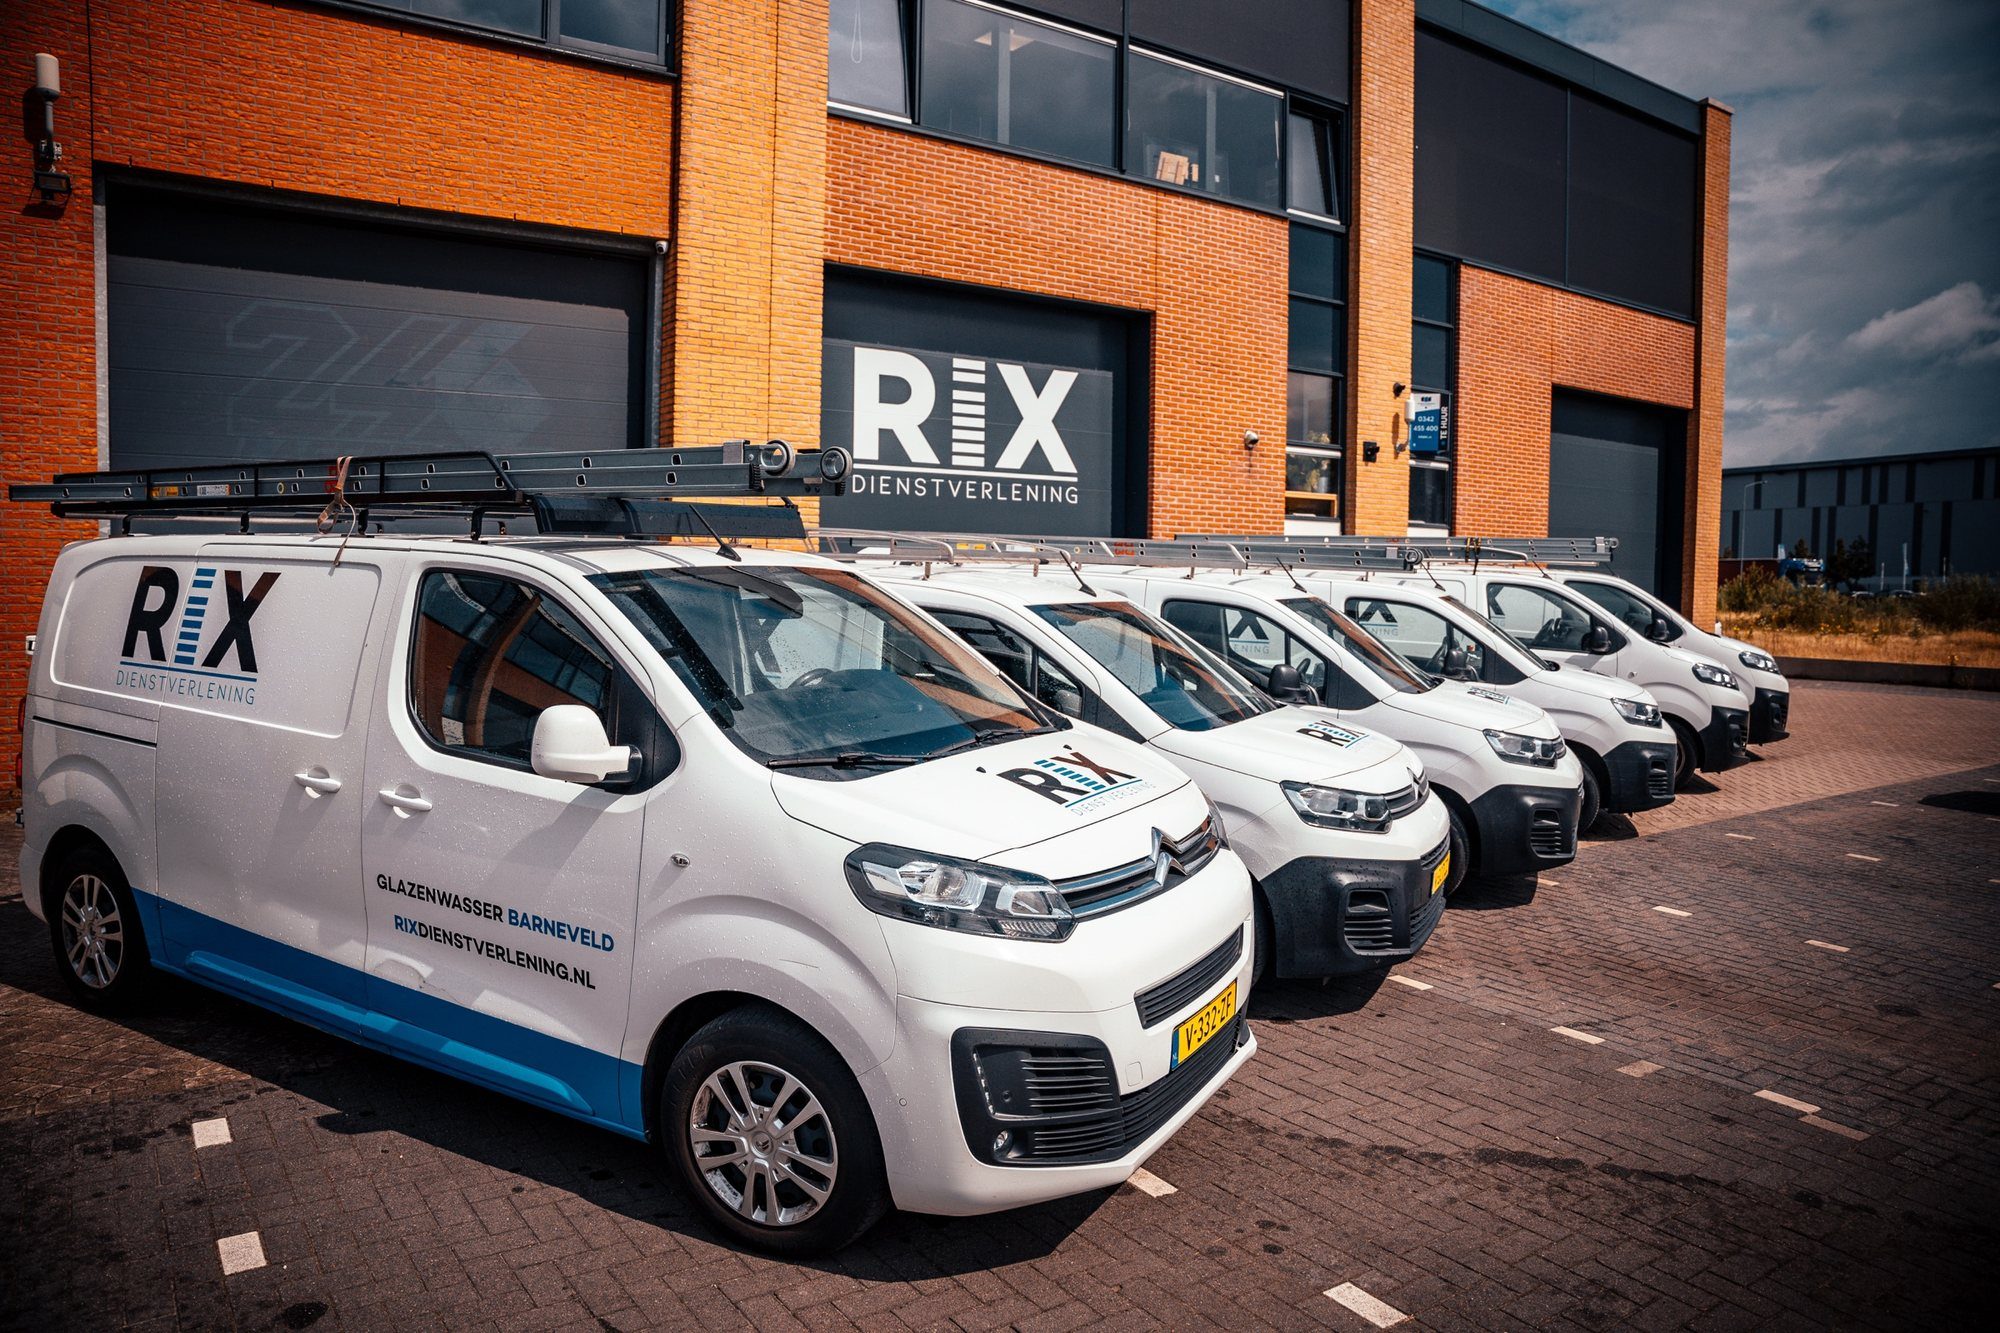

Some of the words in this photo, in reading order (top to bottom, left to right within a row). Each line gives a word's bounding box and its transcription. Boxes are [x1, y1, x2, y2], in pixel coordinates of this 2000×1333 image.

[853, 346, 1079, 474] RIX
[1440, 430, 1448, 440] TE
[852, 474, 1079, 504] DIENSTVERLENING
[121, 565, 282, 674] RIX
[116, 670, 256, 705] DIENSTVERLENING
[996, 752, 1137, 805] RIX
[376, 874, 504, 923] GLAZENWASSER
[508, 908, 615, 952] BARNEVELD
[394, 914, 596, 990] RIXDIENSTVERLENING.NL
[1185, 991, 1232, 1052] V-332-ZF
